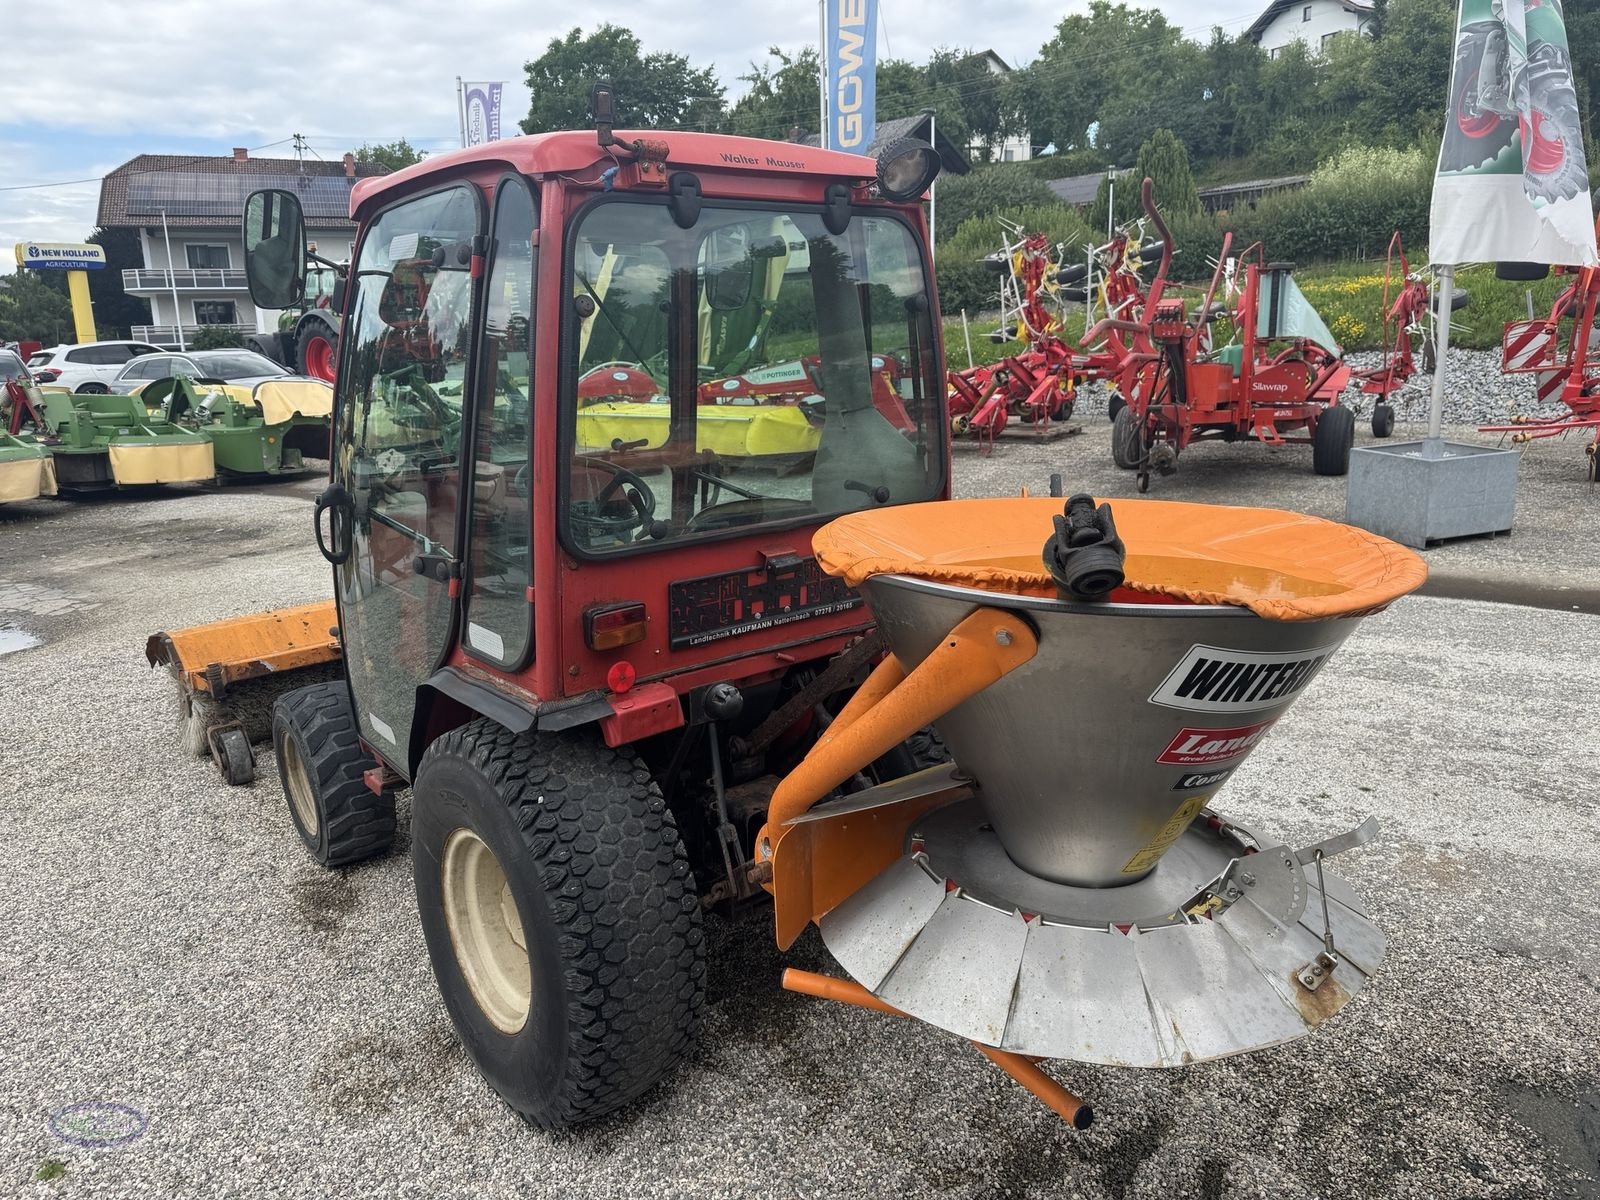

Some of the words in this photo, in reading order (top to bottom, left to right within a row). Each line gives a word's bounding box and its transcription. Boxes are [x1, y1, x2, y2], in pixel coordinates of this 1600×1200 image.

[719, 152, 759, 165] Walter
[765, 157, 806, 169] Mauser
[41, 249, 61, 257] NEW
[62, 249, 100, 257] HOLLAND
[1252, 382, 1288, 393] Silawrap
[689, 630, 730, 645] Landtechnik
[731, 620, 772, 635] KAUFMANN
[773, 612, 810, 627] Natternbach
